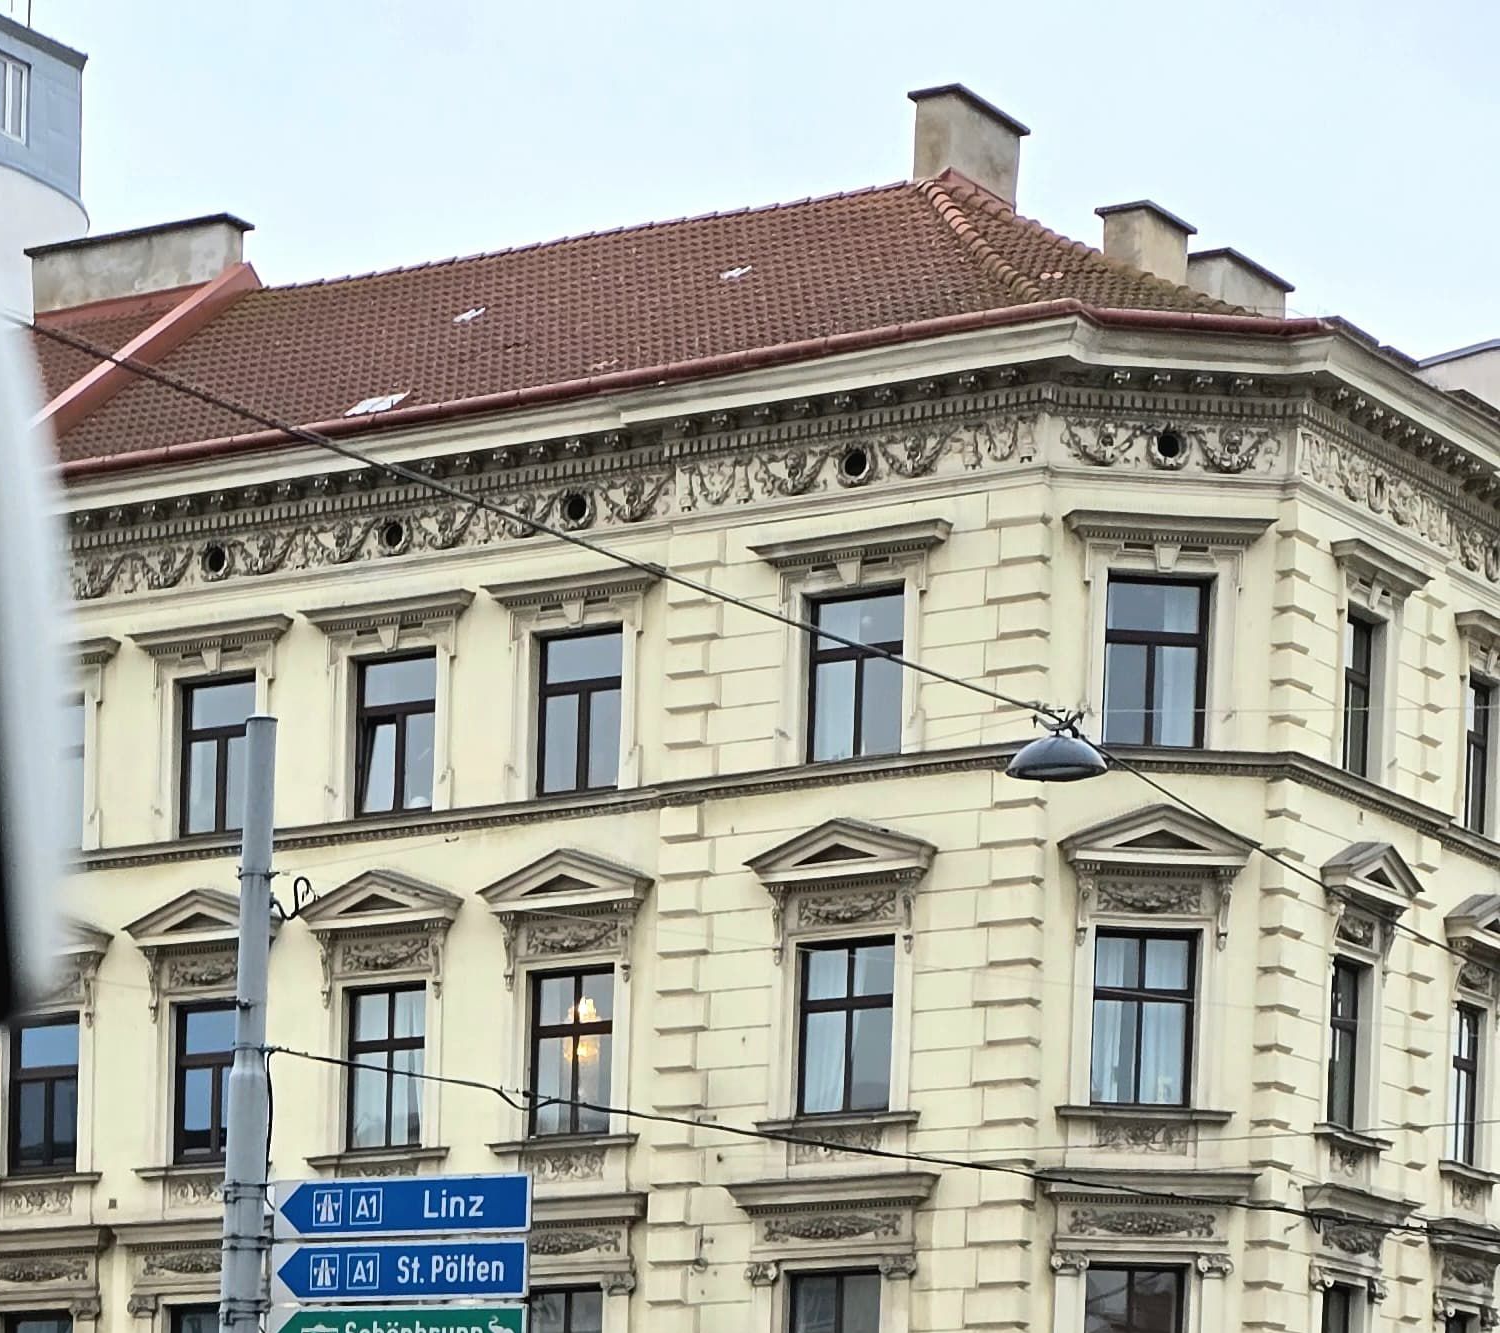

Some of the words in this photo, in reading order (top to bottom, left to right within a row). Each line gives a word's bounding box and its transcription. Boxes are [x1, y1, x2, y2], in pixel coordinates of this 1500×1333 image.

[355, 1194, 377, 1219] A1
[423, 1189, 484, 1219] Linz
[352, 1259, 374, 1284] A1
[396, 1255, 425, 1284] St.
[431, 1253, 504, 1283] Pölten
